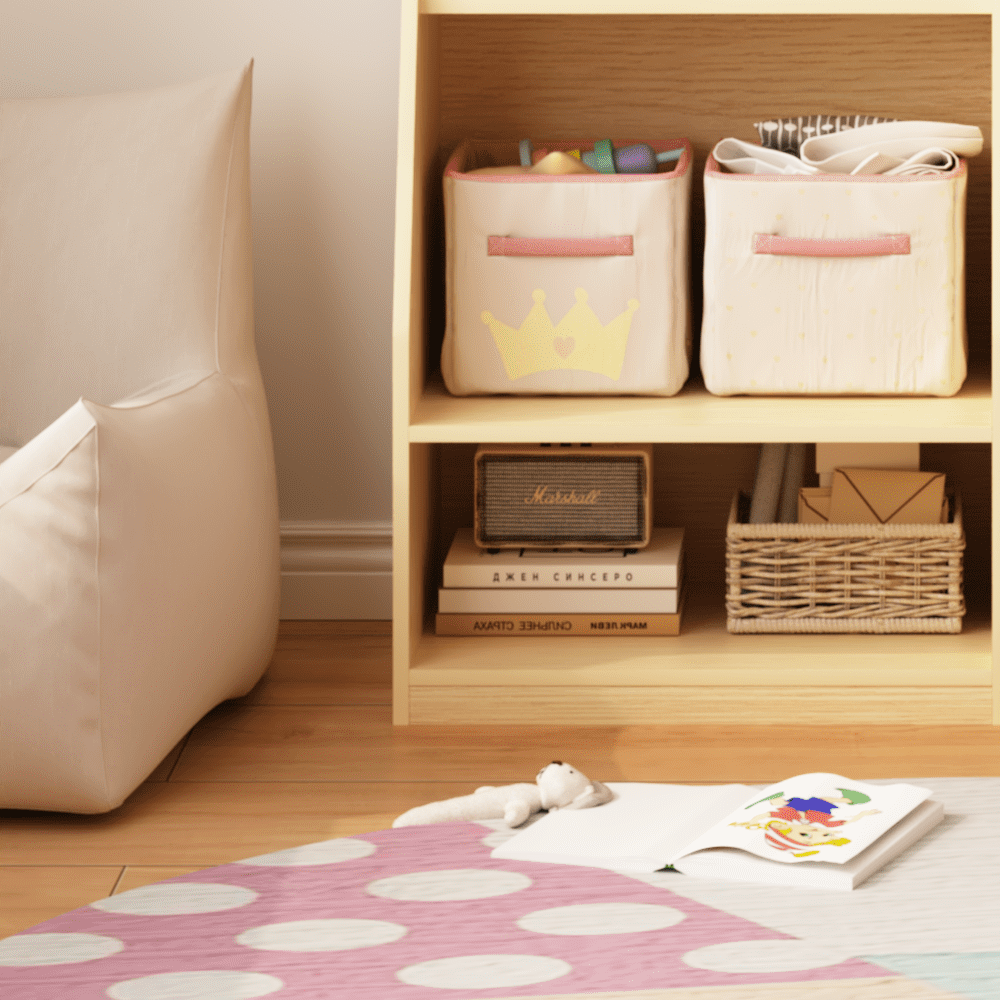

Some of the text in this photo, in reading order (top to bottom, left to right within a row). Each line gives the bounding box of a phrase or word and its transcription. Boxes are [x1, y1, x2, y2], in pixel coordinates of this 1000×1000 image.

[524, 485, 601, 506] Marshall
[493, 572, 633, 582] ДЖЕН СИНСЕРО
